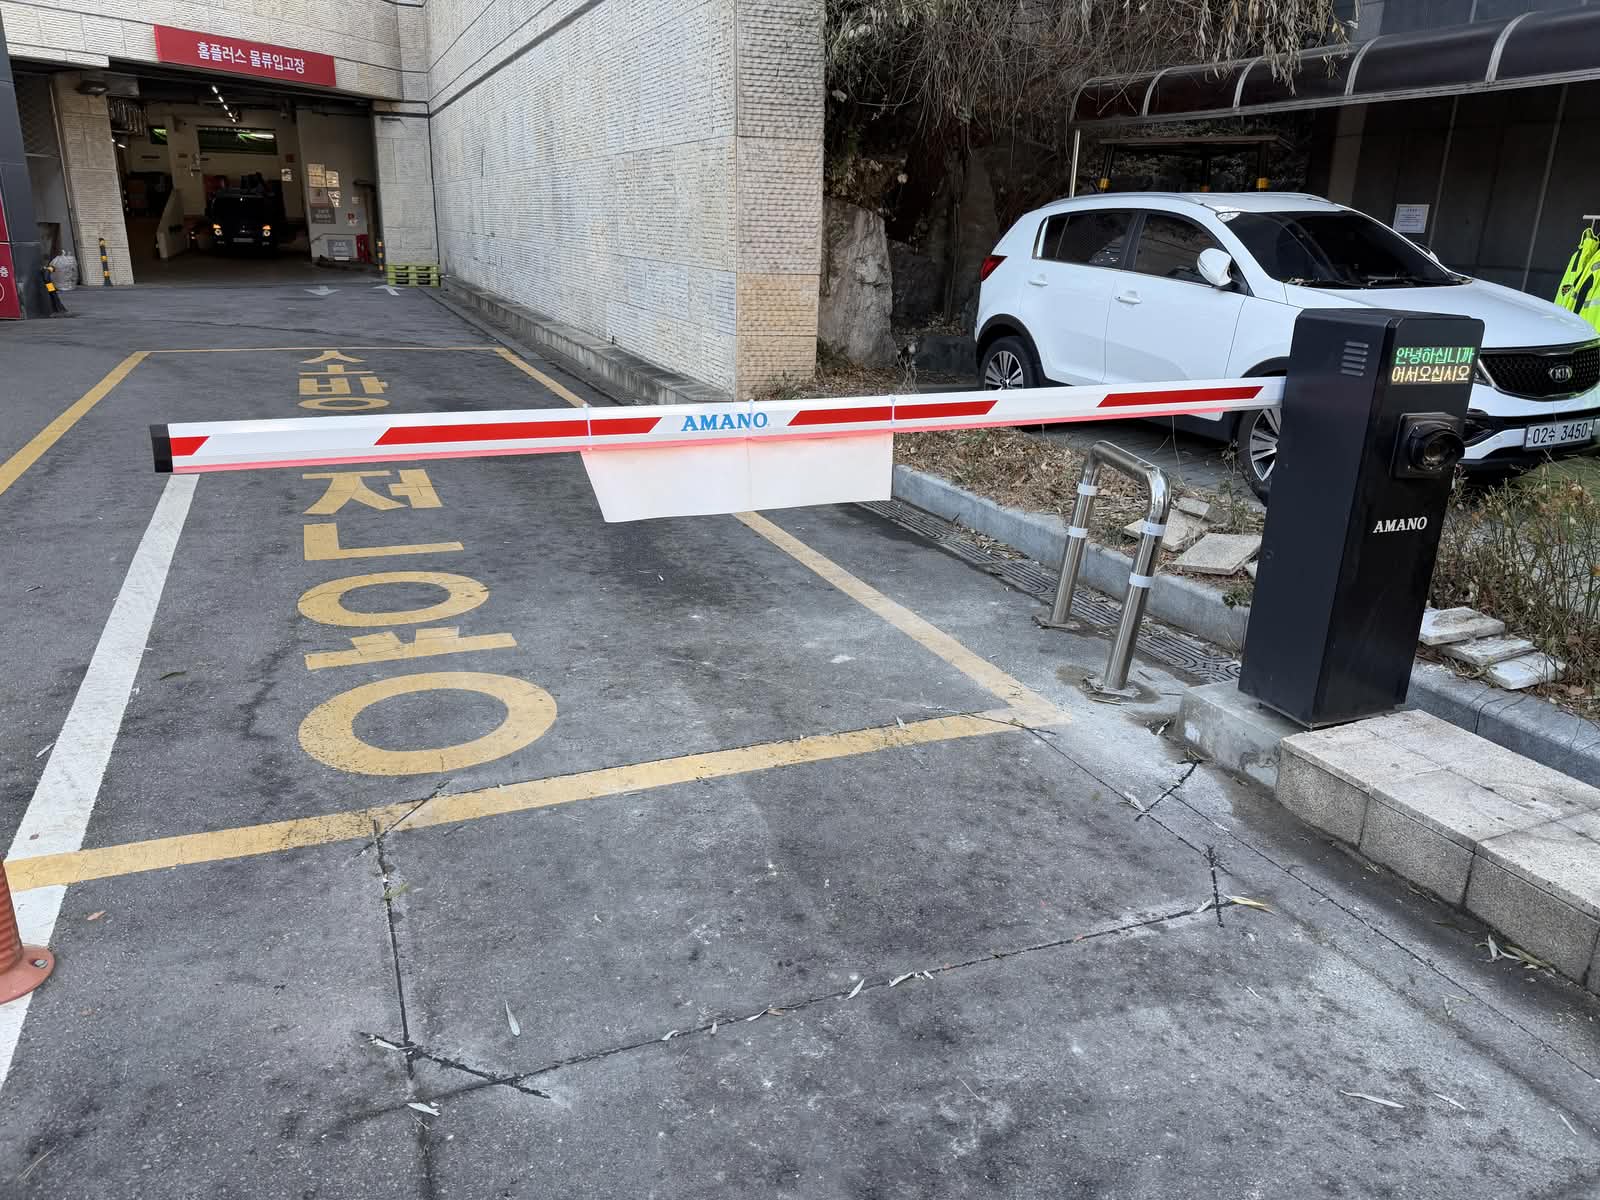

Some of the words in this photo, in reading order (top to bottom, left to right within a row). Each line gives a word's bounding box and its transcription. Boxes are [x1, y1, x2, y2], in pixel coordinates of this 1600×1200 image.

[197, 41, 247, 64] 홈플러스
[250, 50, 305, 75] 물류입고장
[1395, 347, 1475, 365] 안녕하십니까
[1391, 365, 1470, 383] 어서오십시오
[1554, 367, 1572, 380] KIA
[680, 411, 769, 432] AMANO
[1532, 427, 1557, 445] 02수
[1560, 422, 1589, 441] 3450
[1372, 516, 1428, 534] AMANO
